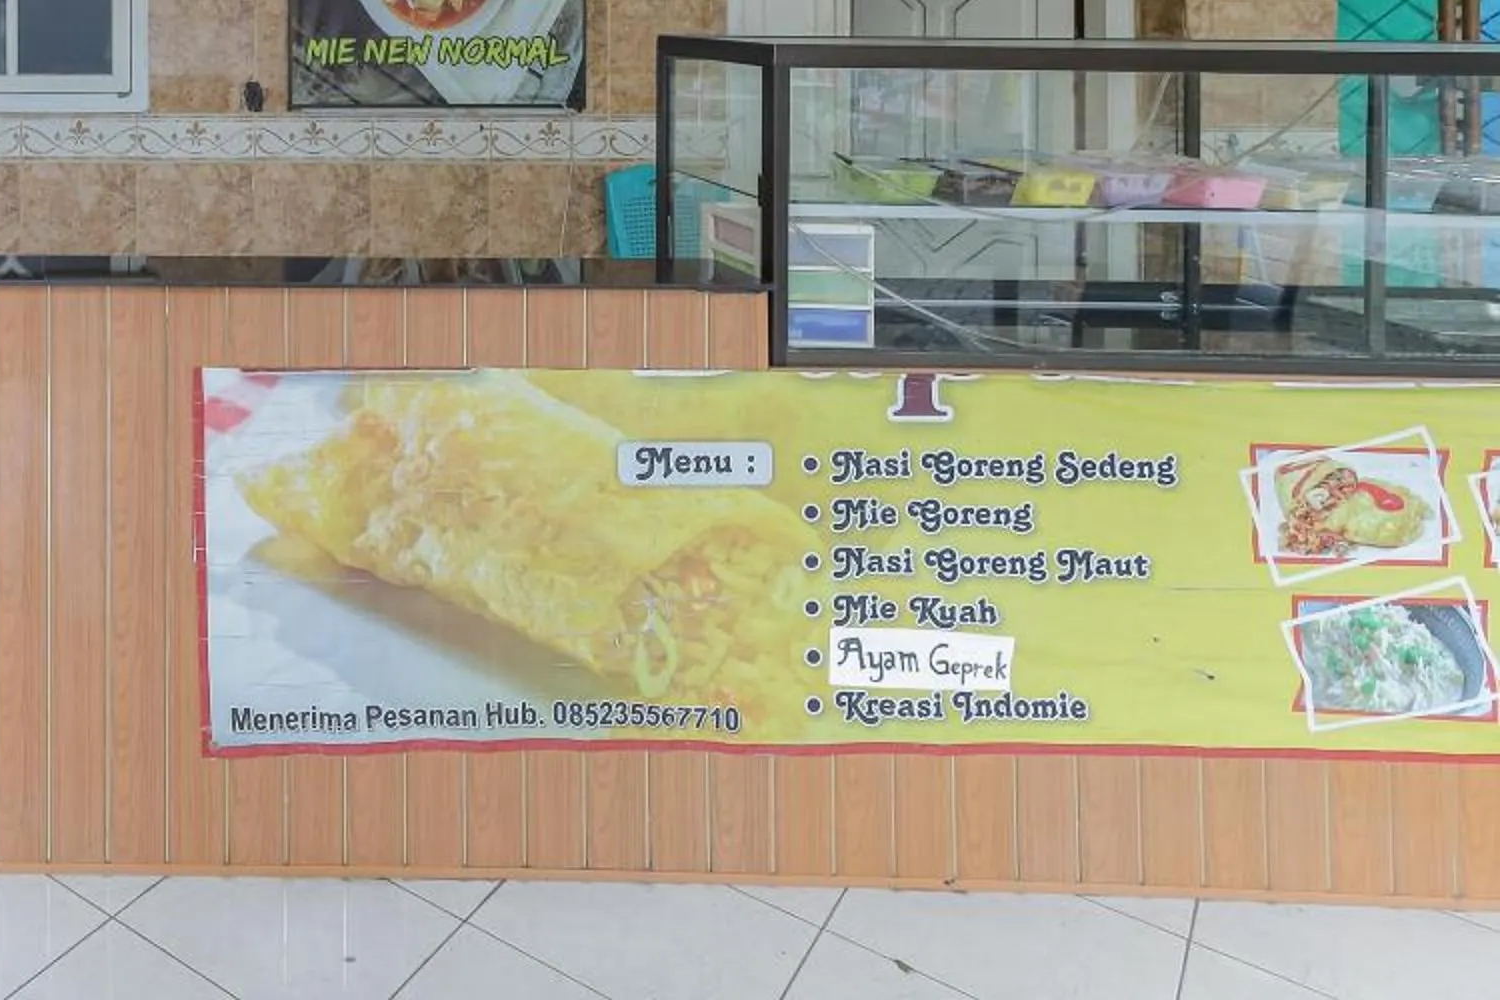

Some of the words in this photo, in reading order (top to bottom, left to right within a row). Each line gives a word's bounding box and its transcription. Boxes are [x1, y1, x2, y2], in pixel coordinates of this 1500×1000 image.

[305, 36, 357, 66] MIE
[362, 34, 432, 67] NEW
[437, 36, 571, 70] NORMAL
[634, 446, 733, 481] Menu
[831, 450, 912, 484] Nasi
[921, 450, 1046, 485] Goreng
[1055, 450, 1178, 486] Sedeng
[832, 499, 898, 533] Mie
[907, 499, 1034, 533] Goreng
[832, 547, 914, 579] Nasi
[923, 547, 1048, 582] Goreng
[1056, 549, 1150, 580] Maut
[833, 595, 898, 627] Mie
[908, 596, 998, 630] Kuah
[837, 636, 921, 683] Ayam
[929, 642, 1009, 685] Geprek
[230, 705, 358, 733] Menerima
[366, 703, 479, 730] Pesanan
[485, 701, 547, 728] Hub.
[553, 700, 740, 733] 085235567710
[835, 690, 945, 726] Kreasi
[952, 691, 1089, 723] Indomie
